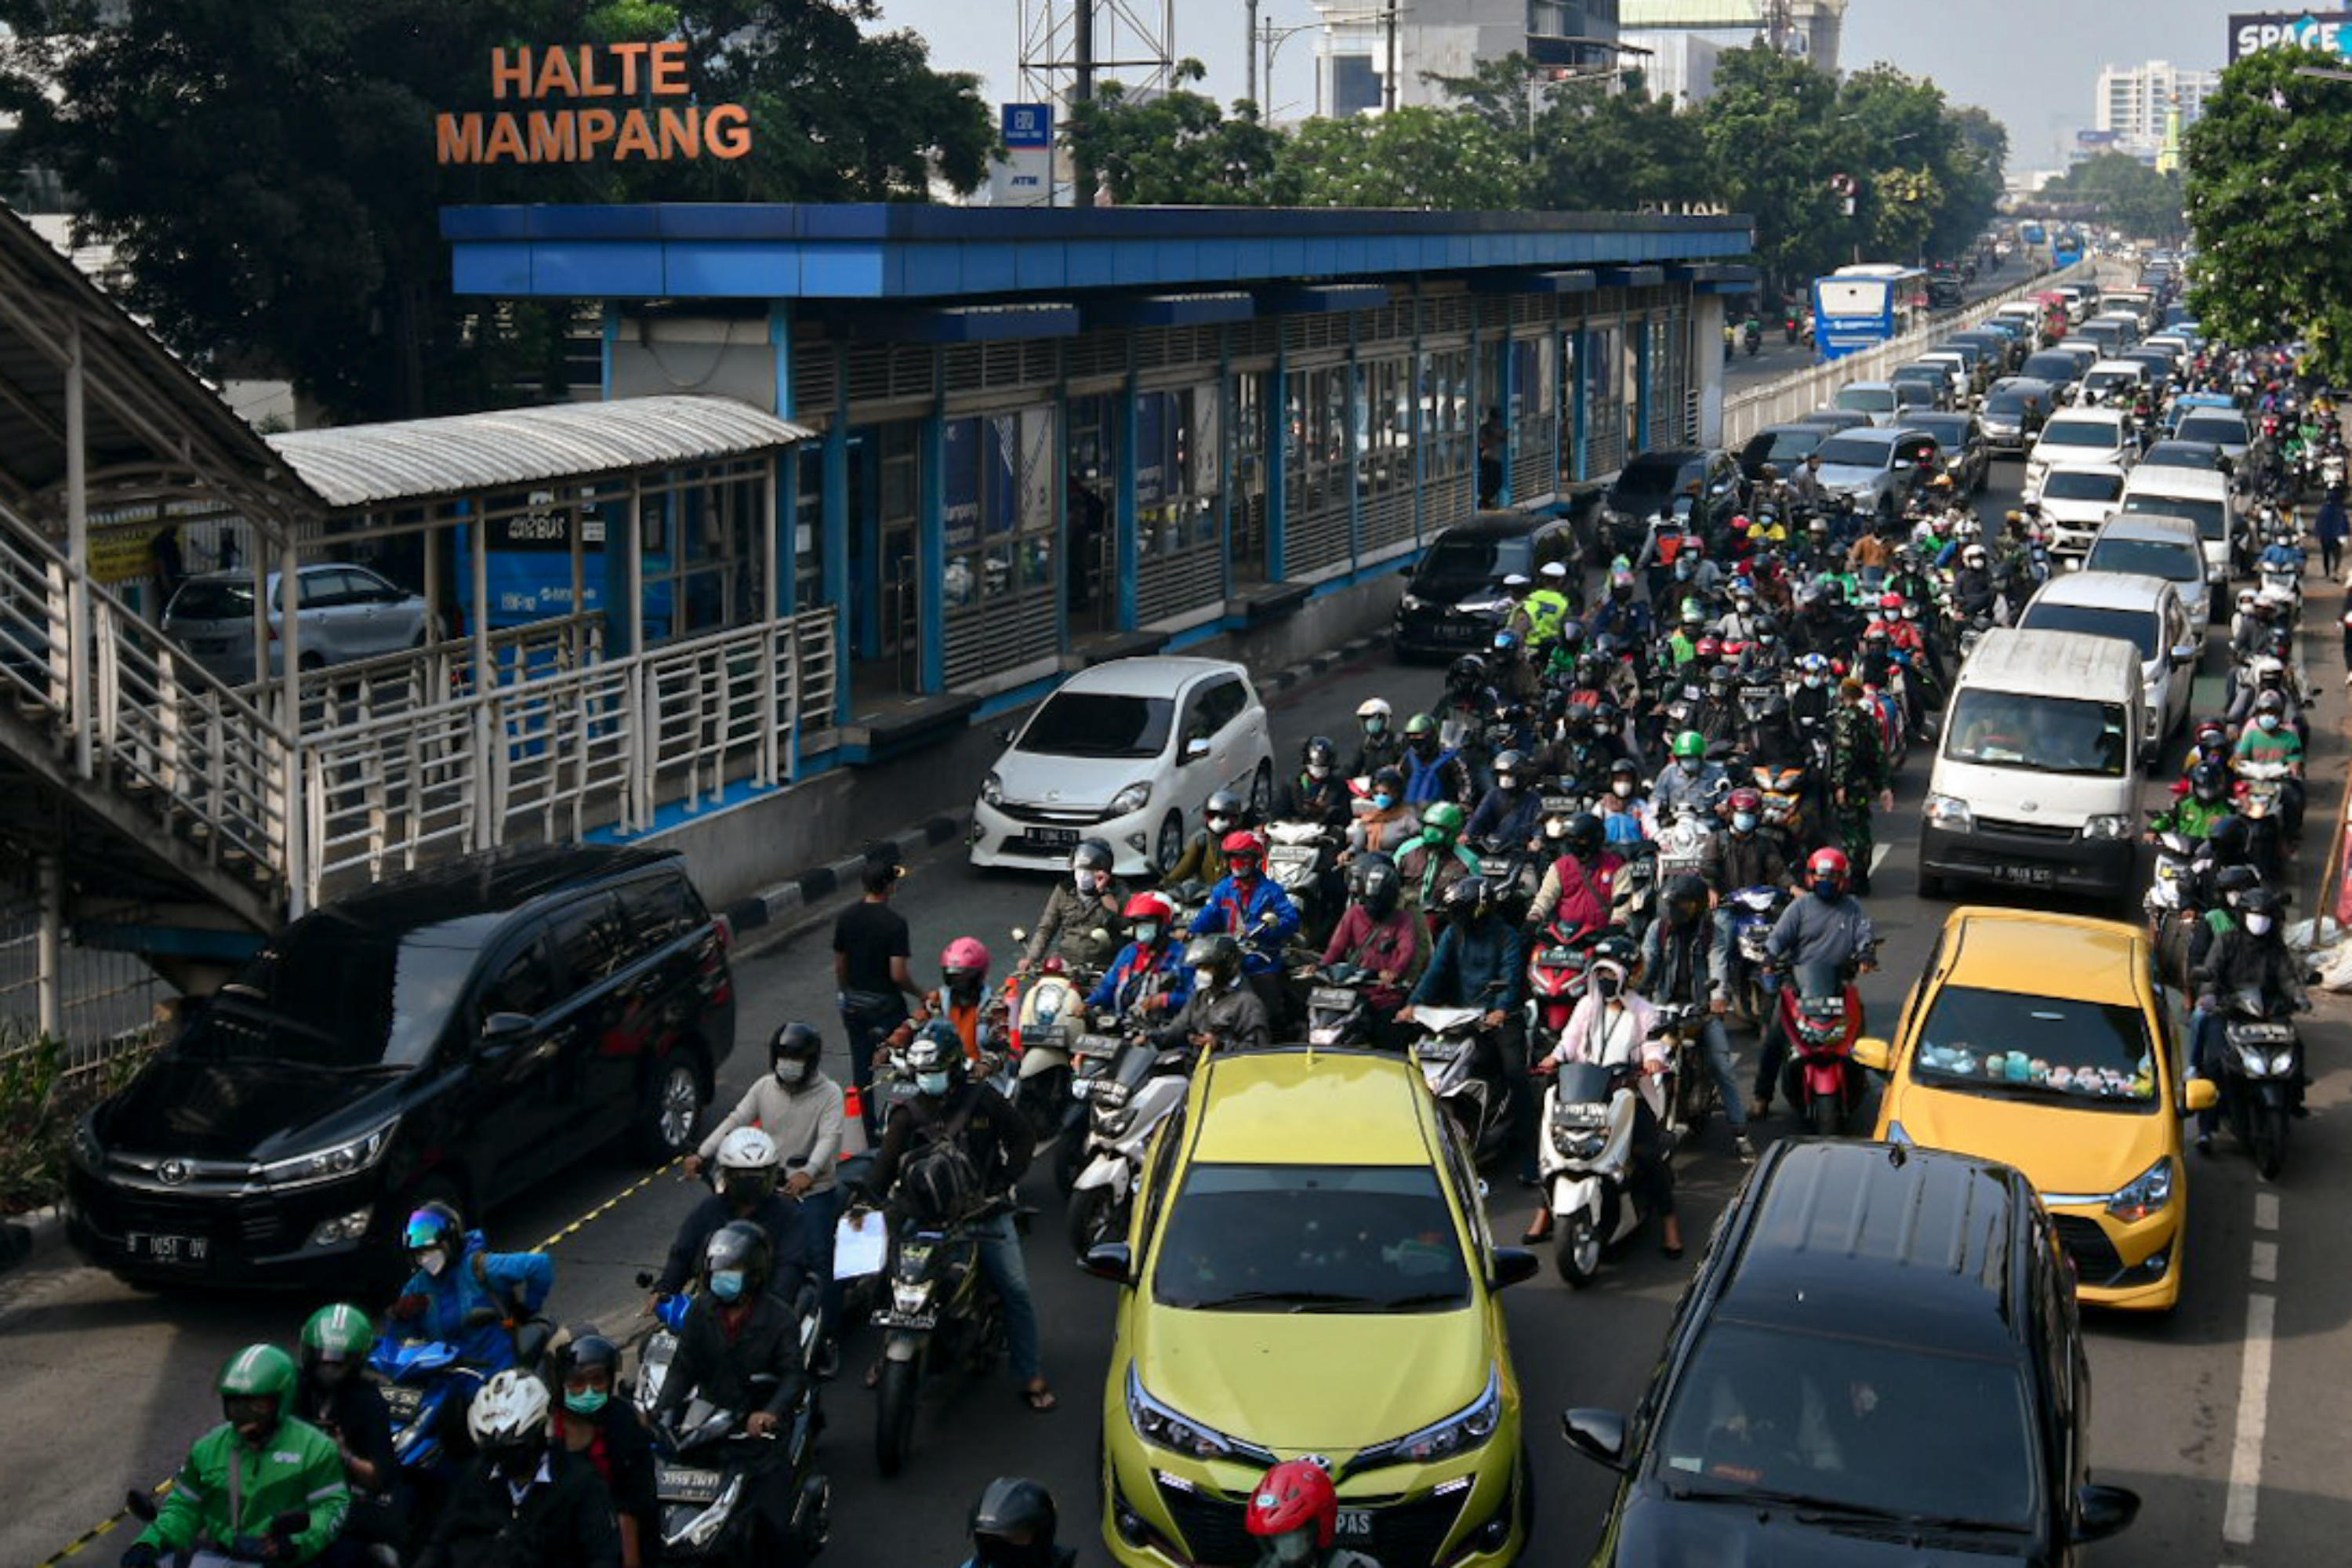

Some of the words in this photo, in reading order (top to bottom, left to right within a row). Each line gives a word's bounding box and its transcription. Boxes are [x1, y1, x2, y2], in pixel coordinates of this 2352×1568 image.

[2238, 23, 2340, 55] SPACE
[492, 42, 690, 100] HALTE
[436, 103, 752, 164] MAMPANG
[1011, 176, 1038, 186] ATM
[1336, 1514, 1370, 1534] PAS
